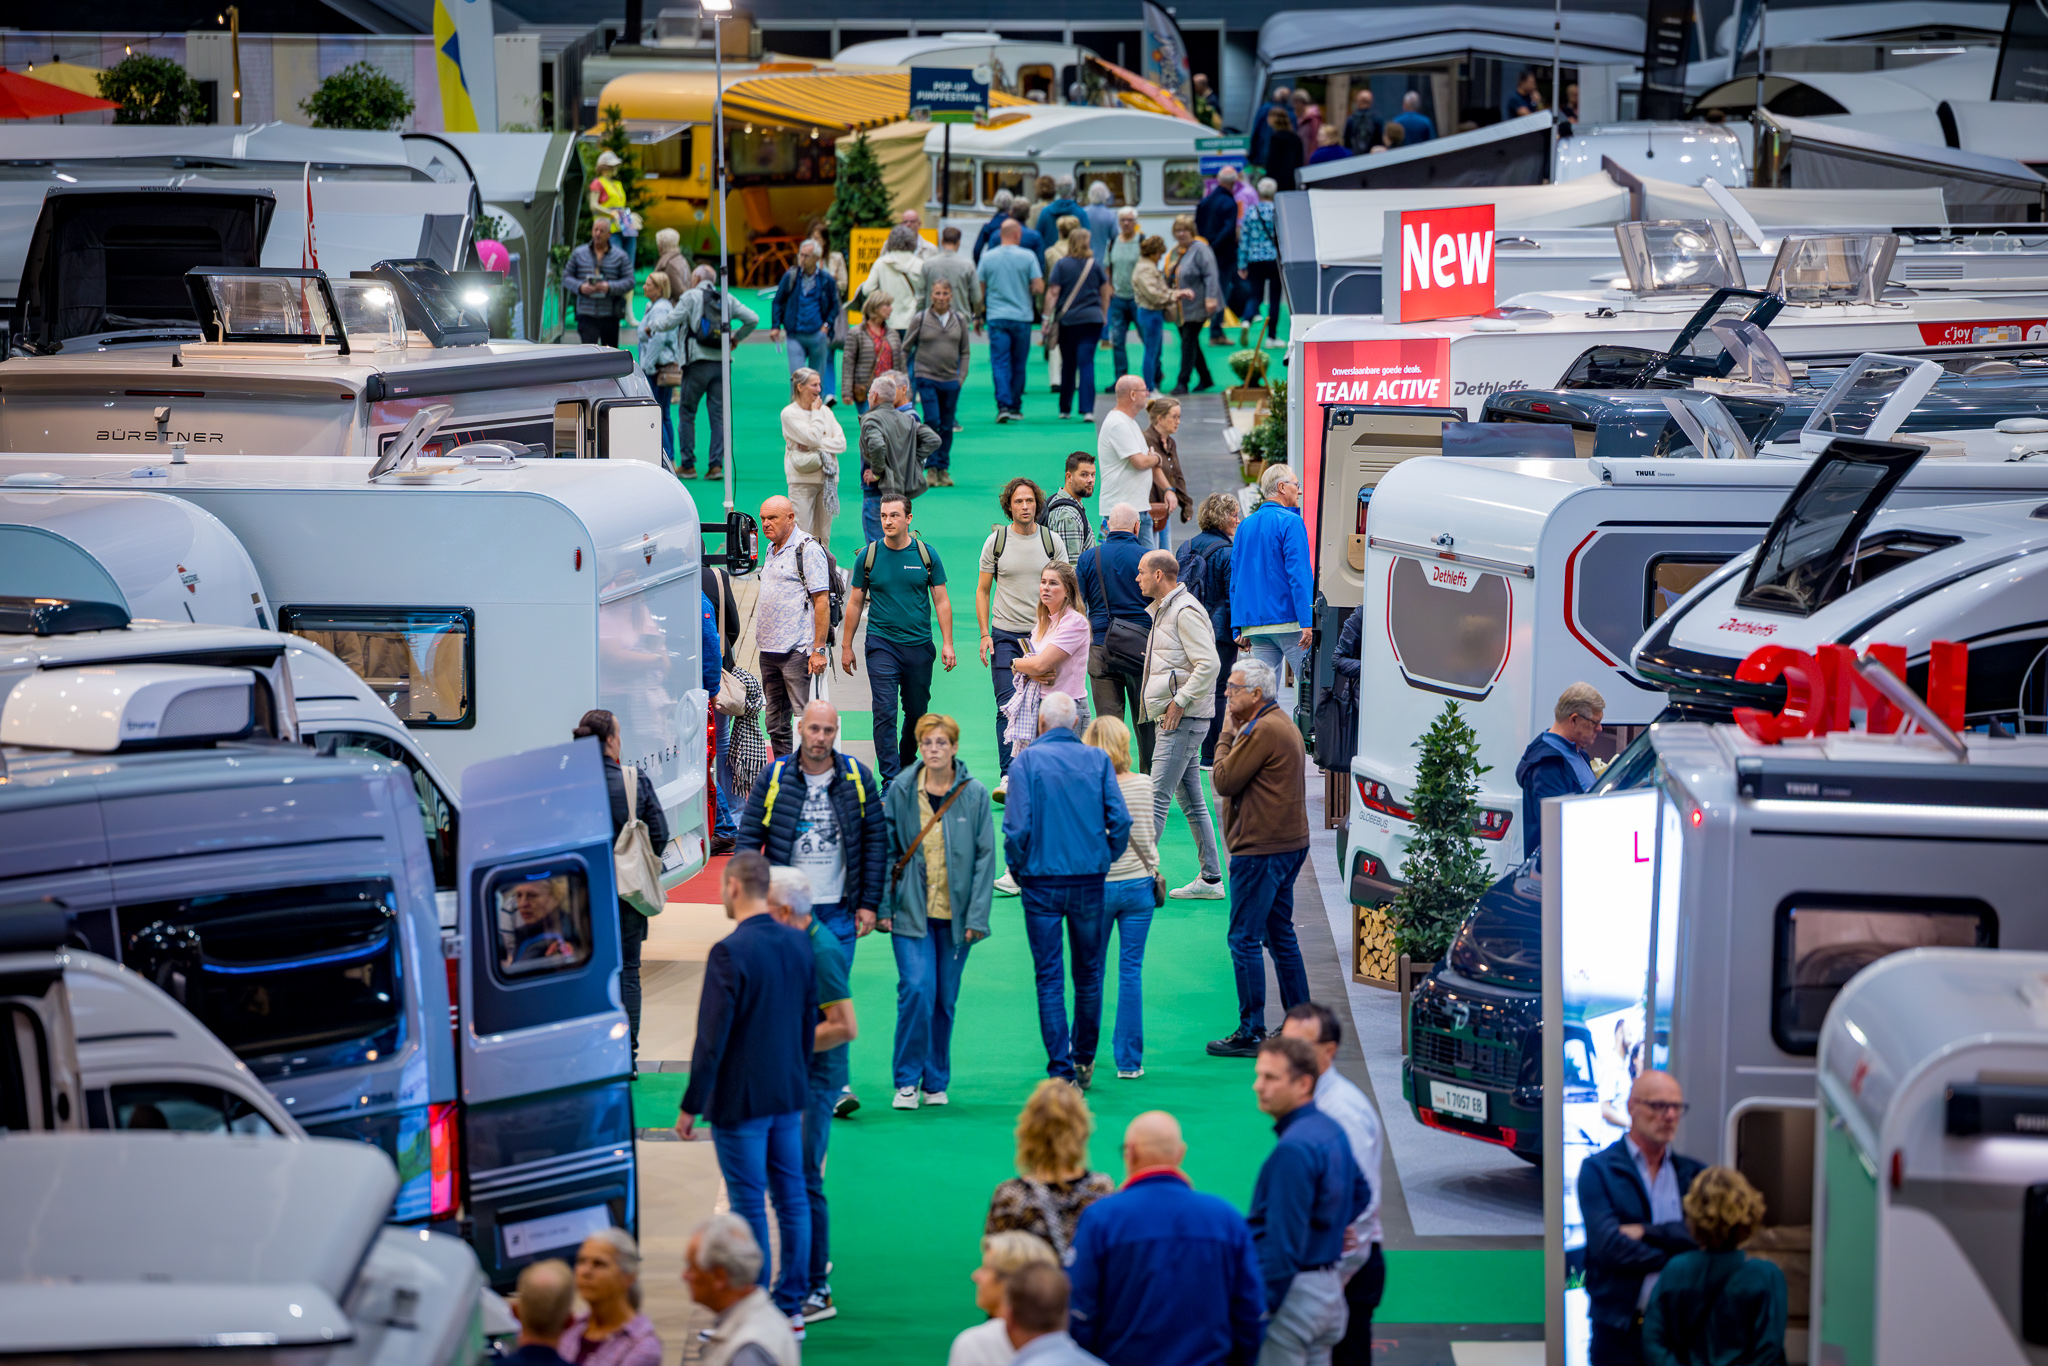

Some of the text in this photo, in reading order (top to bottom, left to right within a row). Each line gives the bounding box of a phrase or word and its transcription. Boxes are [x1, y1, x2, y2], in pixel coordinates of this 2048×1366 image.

[932, 81, 969, 91] POP-UP
[916, 90, 982, 102] PIMPFESTIVAL
[1402, 222, 1494, 291] New
[1944, 326, 1971, 341] c'joy
[1331, 364, 1422, 376] Onverslaanbare goede deals.
[1316, 379, 1441, 402] TEAM ACTIVE
[96, 428, 223, 442] BÜRSTNER
[1433, 565, 1467, 587] Dethleffs
[1718, 617, 1778, 637] Dethleffs
[1358, 810, 1389, 829] GLOBEBUS
[1452, 1093, 1470, 1110] 7057
